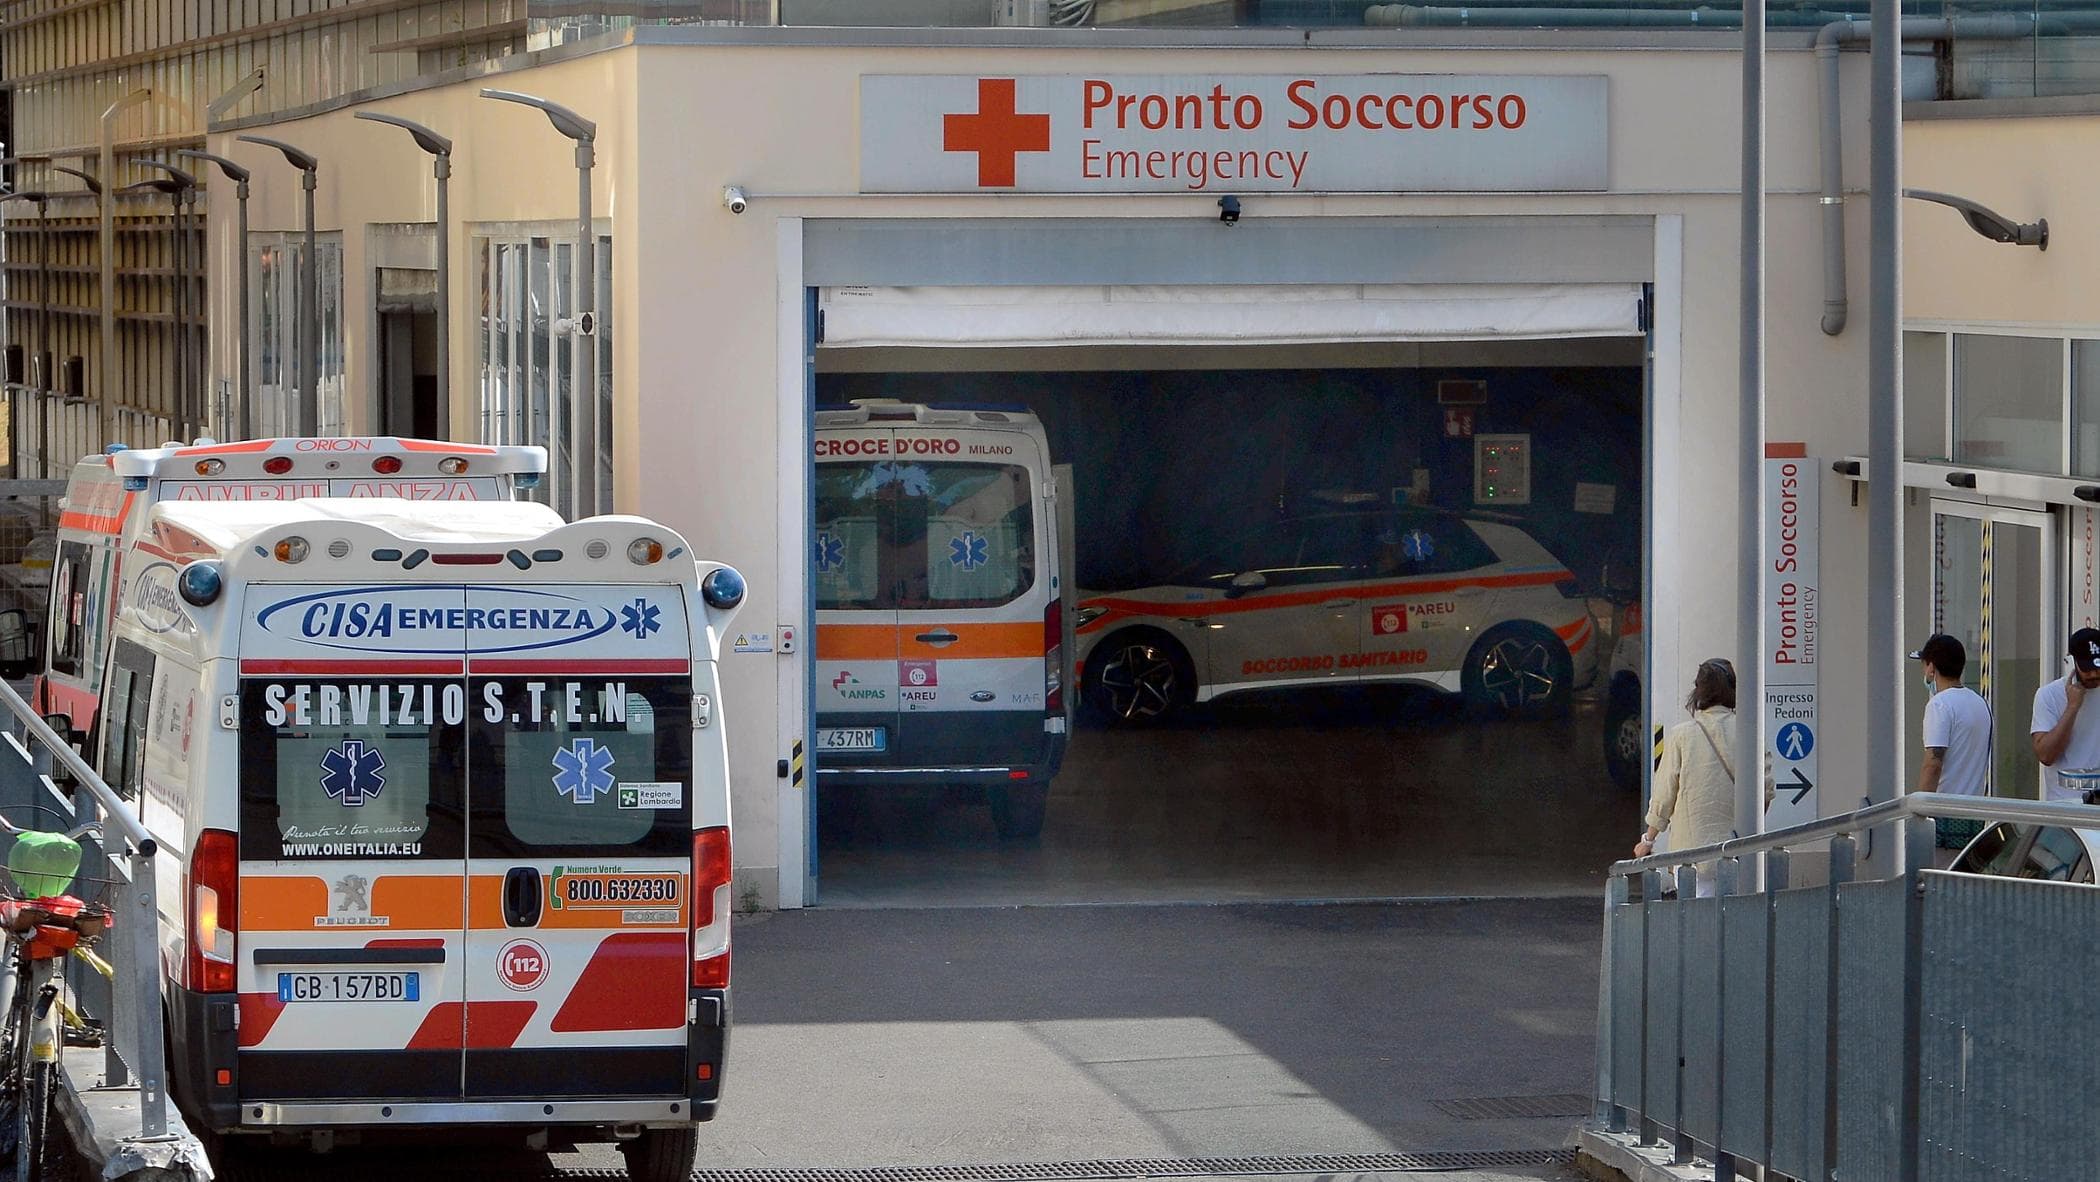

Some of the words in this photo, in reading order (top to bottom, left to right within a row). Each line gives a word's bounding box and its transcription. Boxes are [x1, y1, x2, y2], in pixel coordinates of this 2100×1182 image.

[1082, 79, 1263, 130] Pronto
[1286, 79, 1527, 131] Soccorso
[1081, 139, 1309, 189] Emergency
[295, 438, 372, 453] ORION
[815, 439, 889, 456] CROCE
[896, 438, 961, 455] D'ORO
[968, 445, 1013, 455] MILANO
[1775, 463, 1798, 573] Soccorso
[1415, 602, 1455, 616] AREU
[301, 602, 393, 638] CISA
[398, 608, 595, 630] EMERGENZA
[1775, 582, 1797, 664] Pronto
[1800, 586, 1817, 664] Emergency
[1240, 655, 1334, 675] SOCCORSO
[1337, 648, 1429, 669] SANITARIO
[848, 689, 886, 700] ANPAS
[906, 691, 937, 701] AREU
[1765, 692, 1814, 706] Ingresso
[264, 683, 464, 726] SERVIZIO
[1774, 707, 1814, 719] Pedoni
[827, 730, 874, 747] 437RM
[640, 790, 672, 799] Regione
[282, 824, 334, 841] Prenota
[335, 824, 348, 837] il
[350, 823, 370, 836] tuo
[373, 821, 422, 835] servizio
[282, 843, 422, 857] WWW.ONEITALIA.EU
[566, 865, 597, 874] Numero
[598, 865, 622, 874] Verde
[568, 879, 676, 900] 800.632330
[316, 917, 388, 925] PEUGEOT
[513, 957, 540, 973] 112
